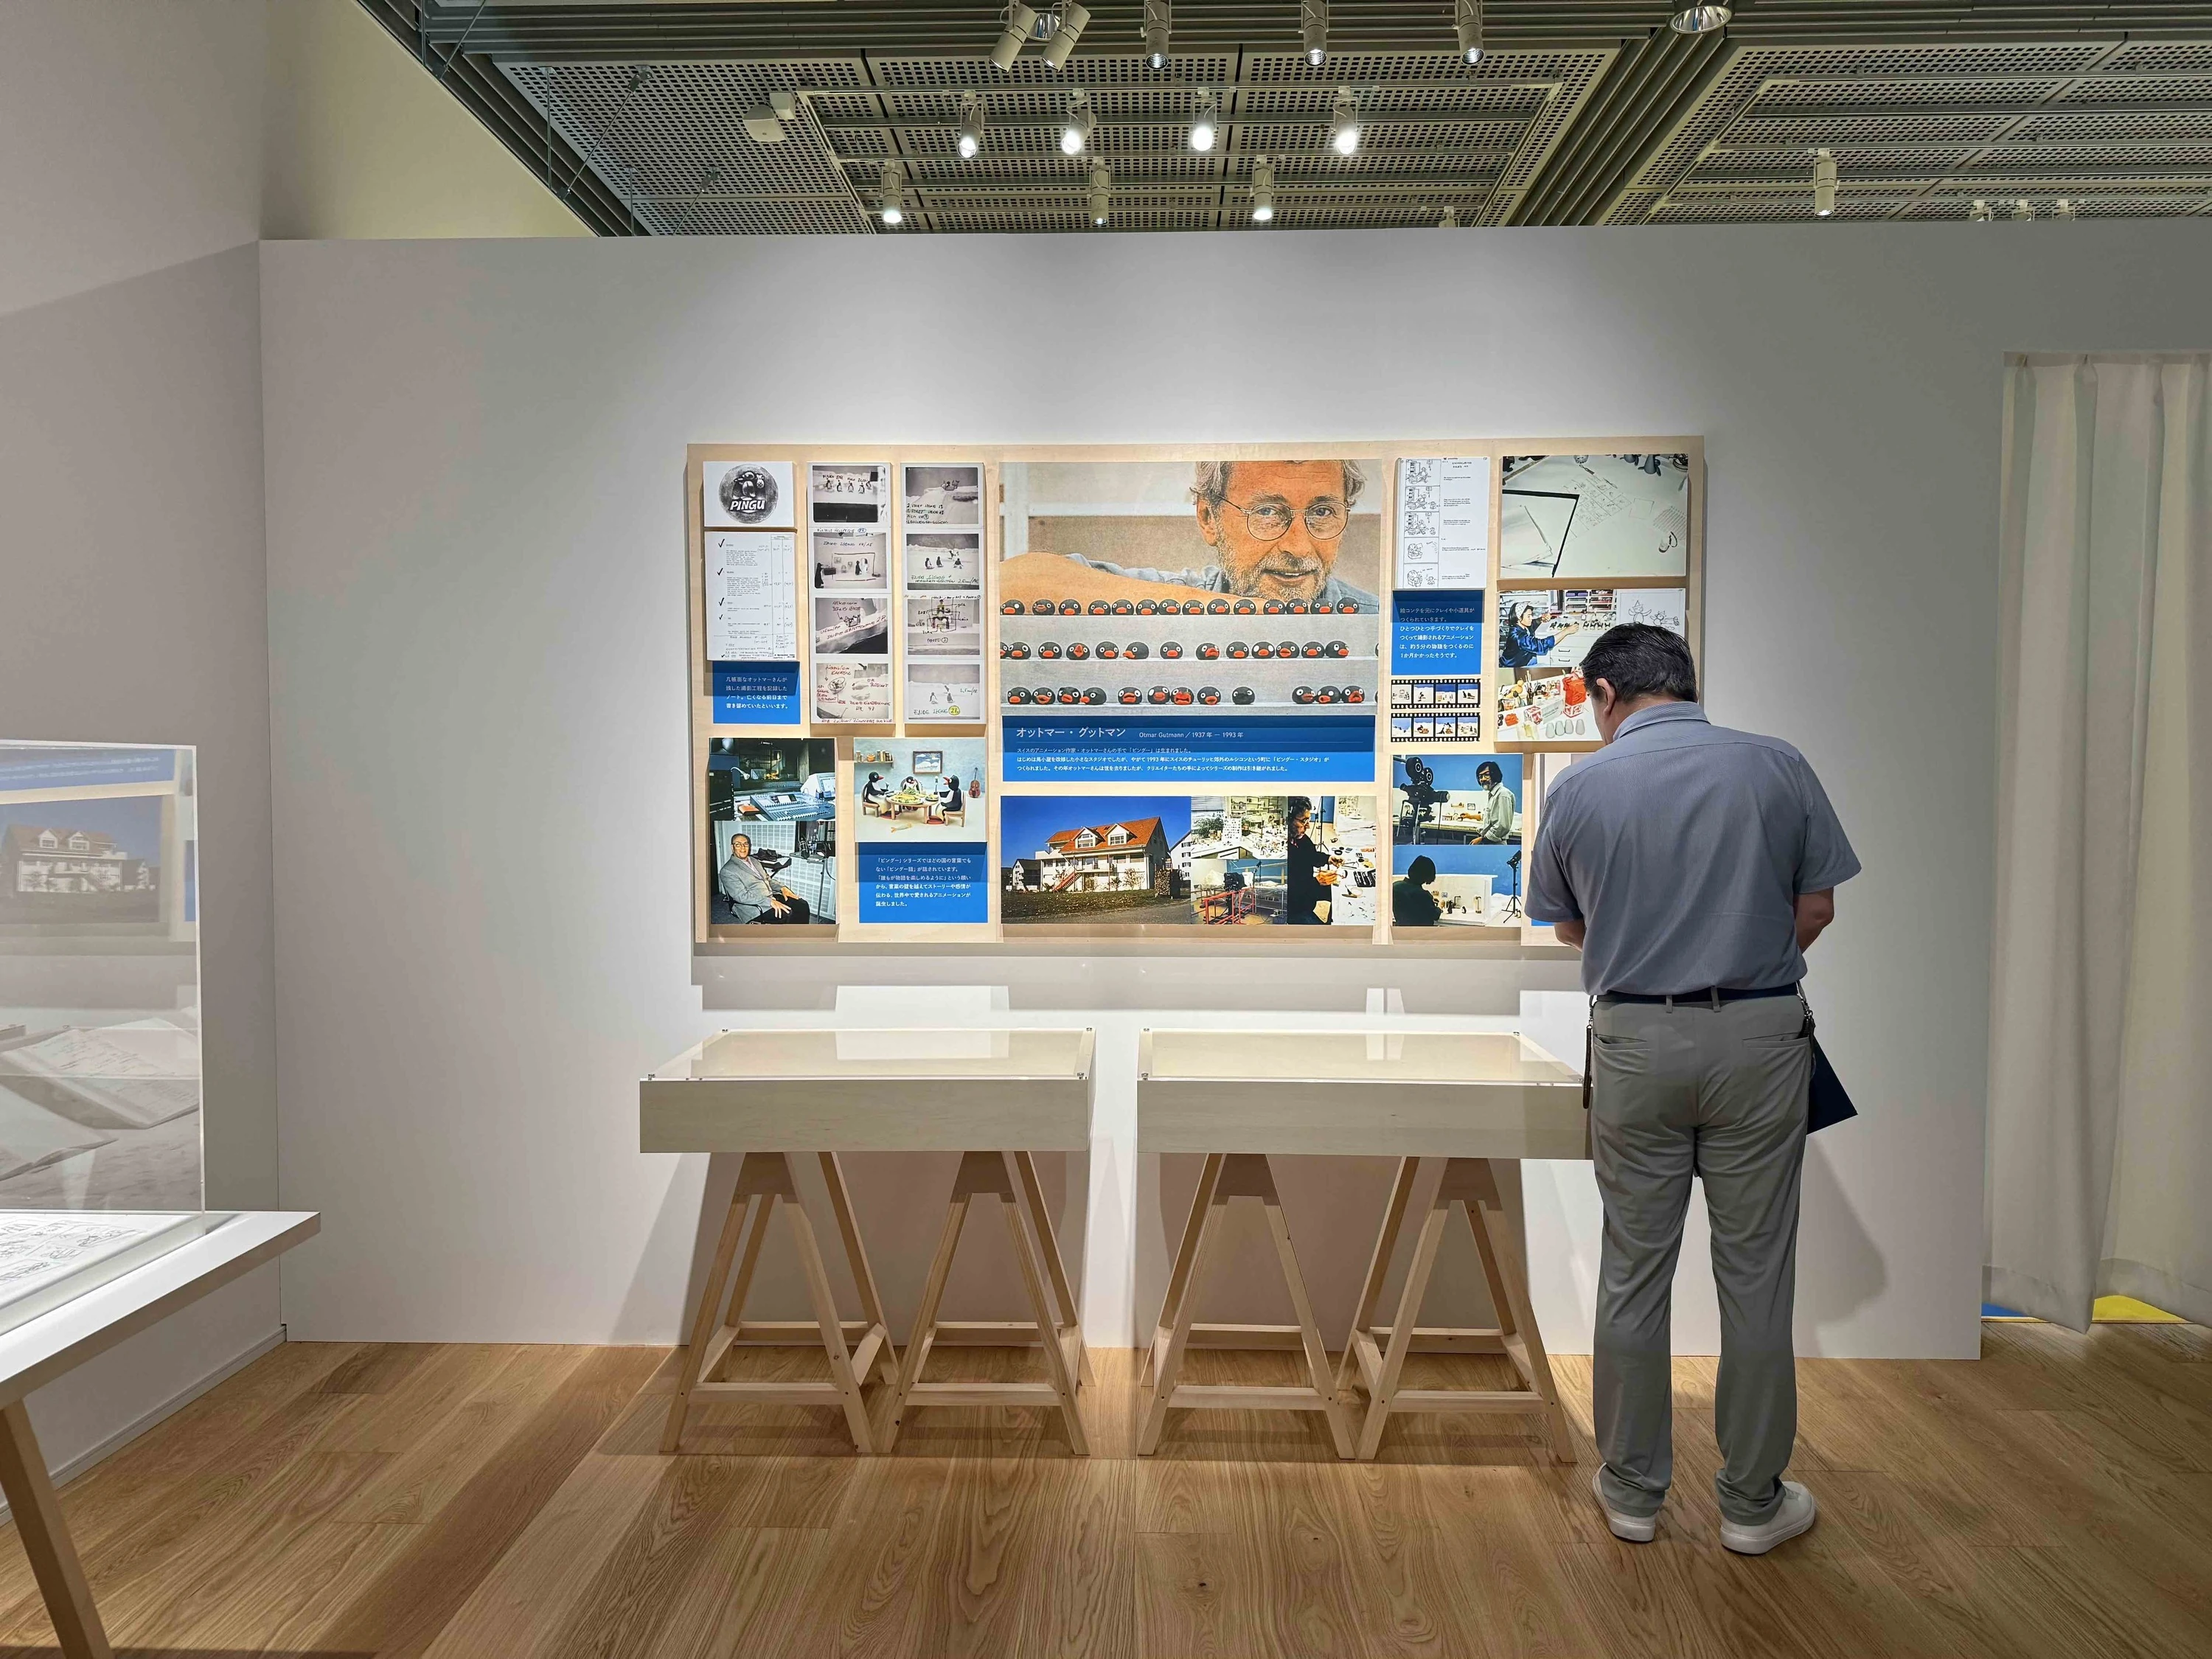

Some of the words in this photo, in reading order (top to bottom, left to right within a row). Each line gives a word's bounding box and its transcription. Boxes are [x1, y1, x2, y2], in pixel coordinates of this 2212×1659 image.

[729, 500, 765, 511] PINGU
[1016, 726, 1126, 737] オットマー・グットマン
